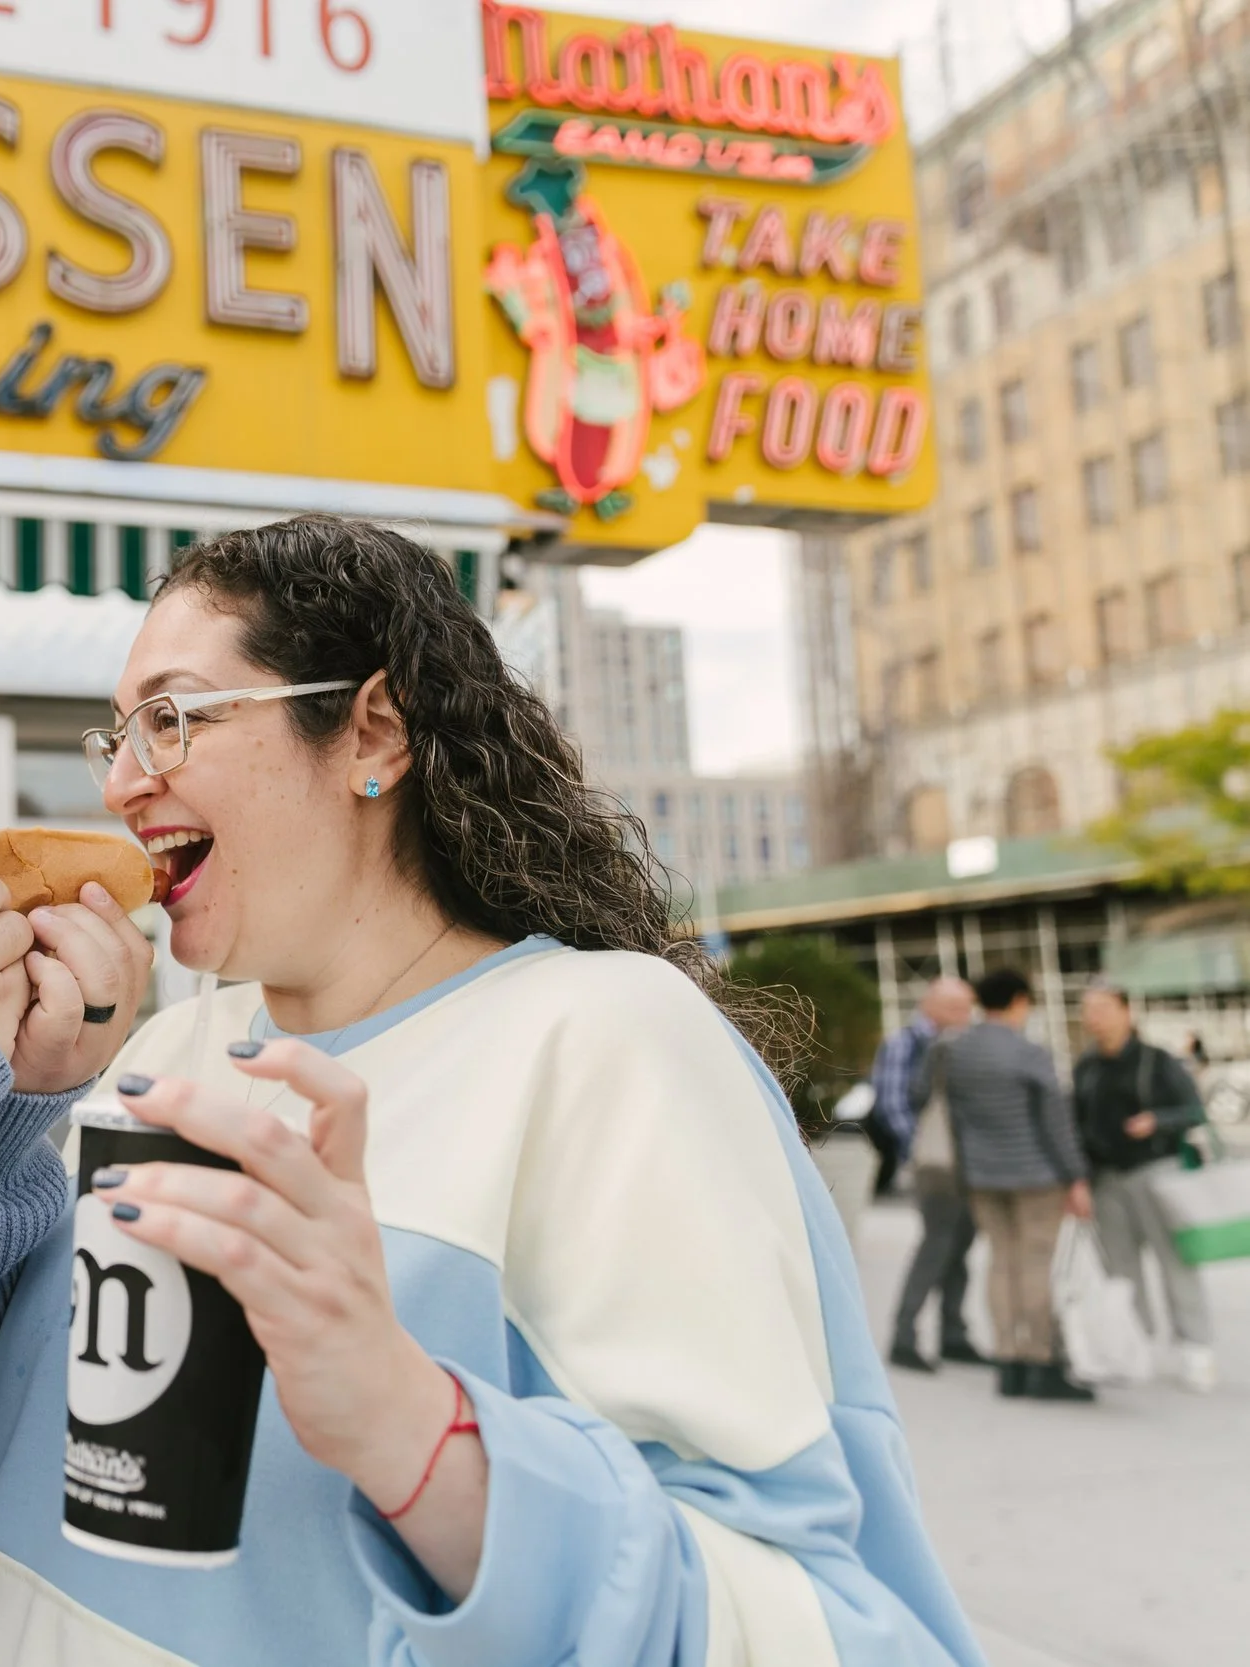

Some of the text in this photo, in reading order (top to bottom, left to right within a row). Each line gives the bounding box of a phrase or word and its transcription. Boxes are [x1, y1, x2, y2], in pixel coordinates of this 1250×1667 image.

[698, 197, 906, 287] TAKE
[709, 283, 925, 374] HOME
[707, 372, 926, 476] FOOD
